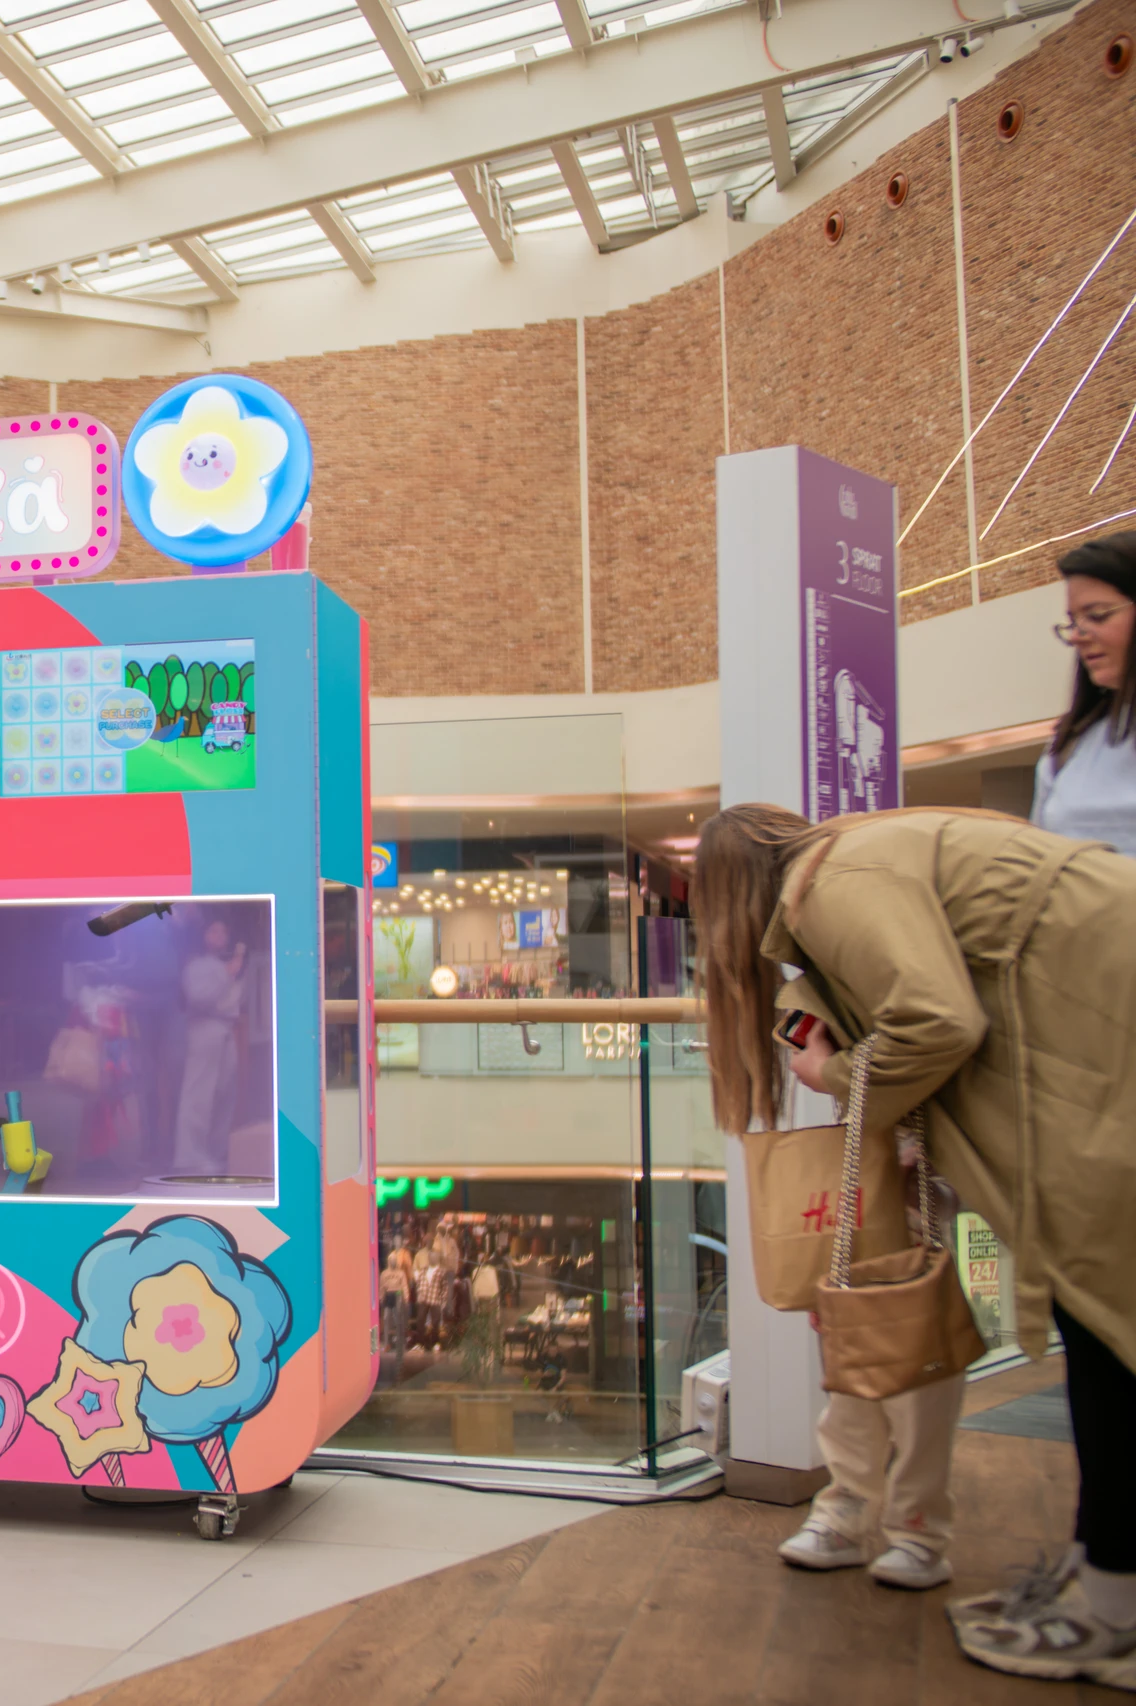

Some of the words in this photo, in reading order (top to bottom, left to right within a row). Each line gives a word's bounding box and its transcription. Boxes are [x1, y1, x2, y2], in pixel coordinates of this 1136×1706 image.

[836, 540, 850, 585] 3
[211, 702, 247, 710] CANDY
[100, 708, 150, 719] SELECT
[98, 720, 153, 731] PURCHASE
[582, 1022, 641, 1046] LORI
[970, 1247, 998, 1258] ONLIN
[971, 1262, 998, 1281] 24/
